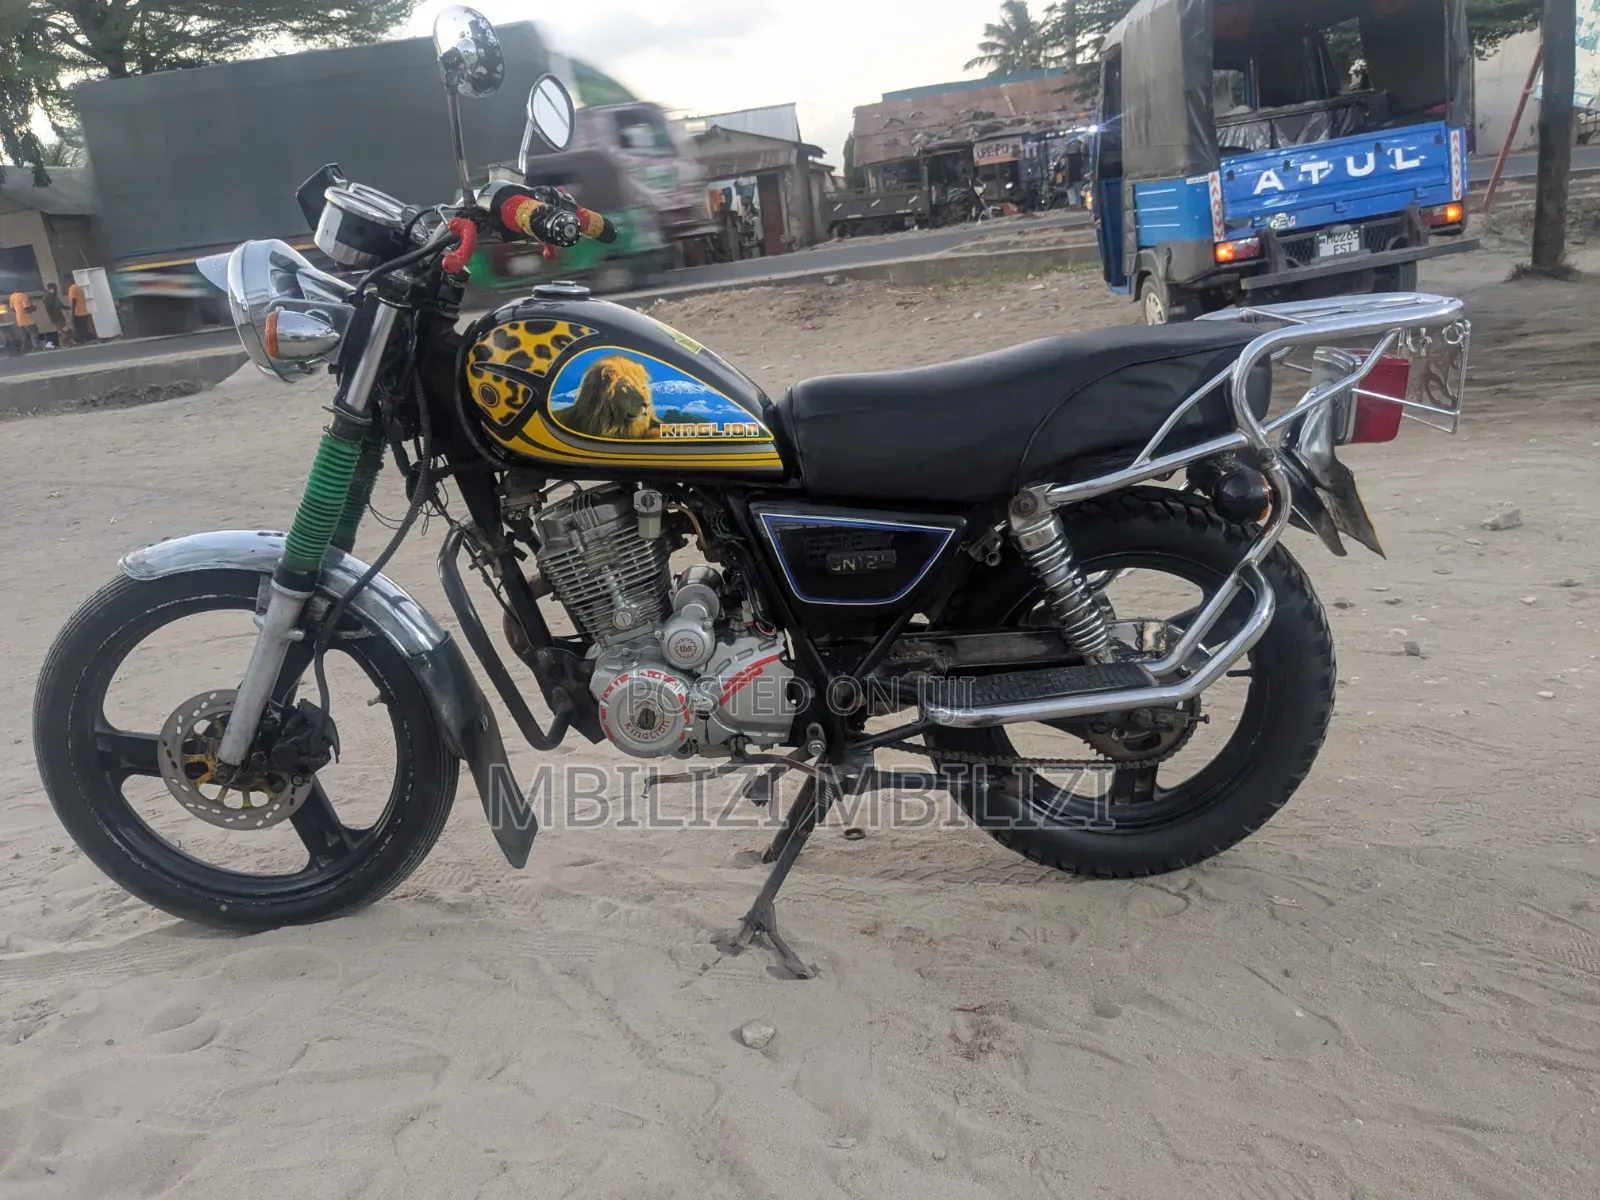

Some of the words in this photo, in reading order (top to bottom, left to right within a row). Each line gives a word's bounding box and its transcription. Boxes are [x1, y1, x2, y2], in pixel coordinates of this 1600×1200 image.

[1253, 148, 1421, 195] ATUL
[1326, 229, 1361, 245] MC265
[1333, 241, 1354, 256] EST
[660, 422, 759, 438] KINGLION
